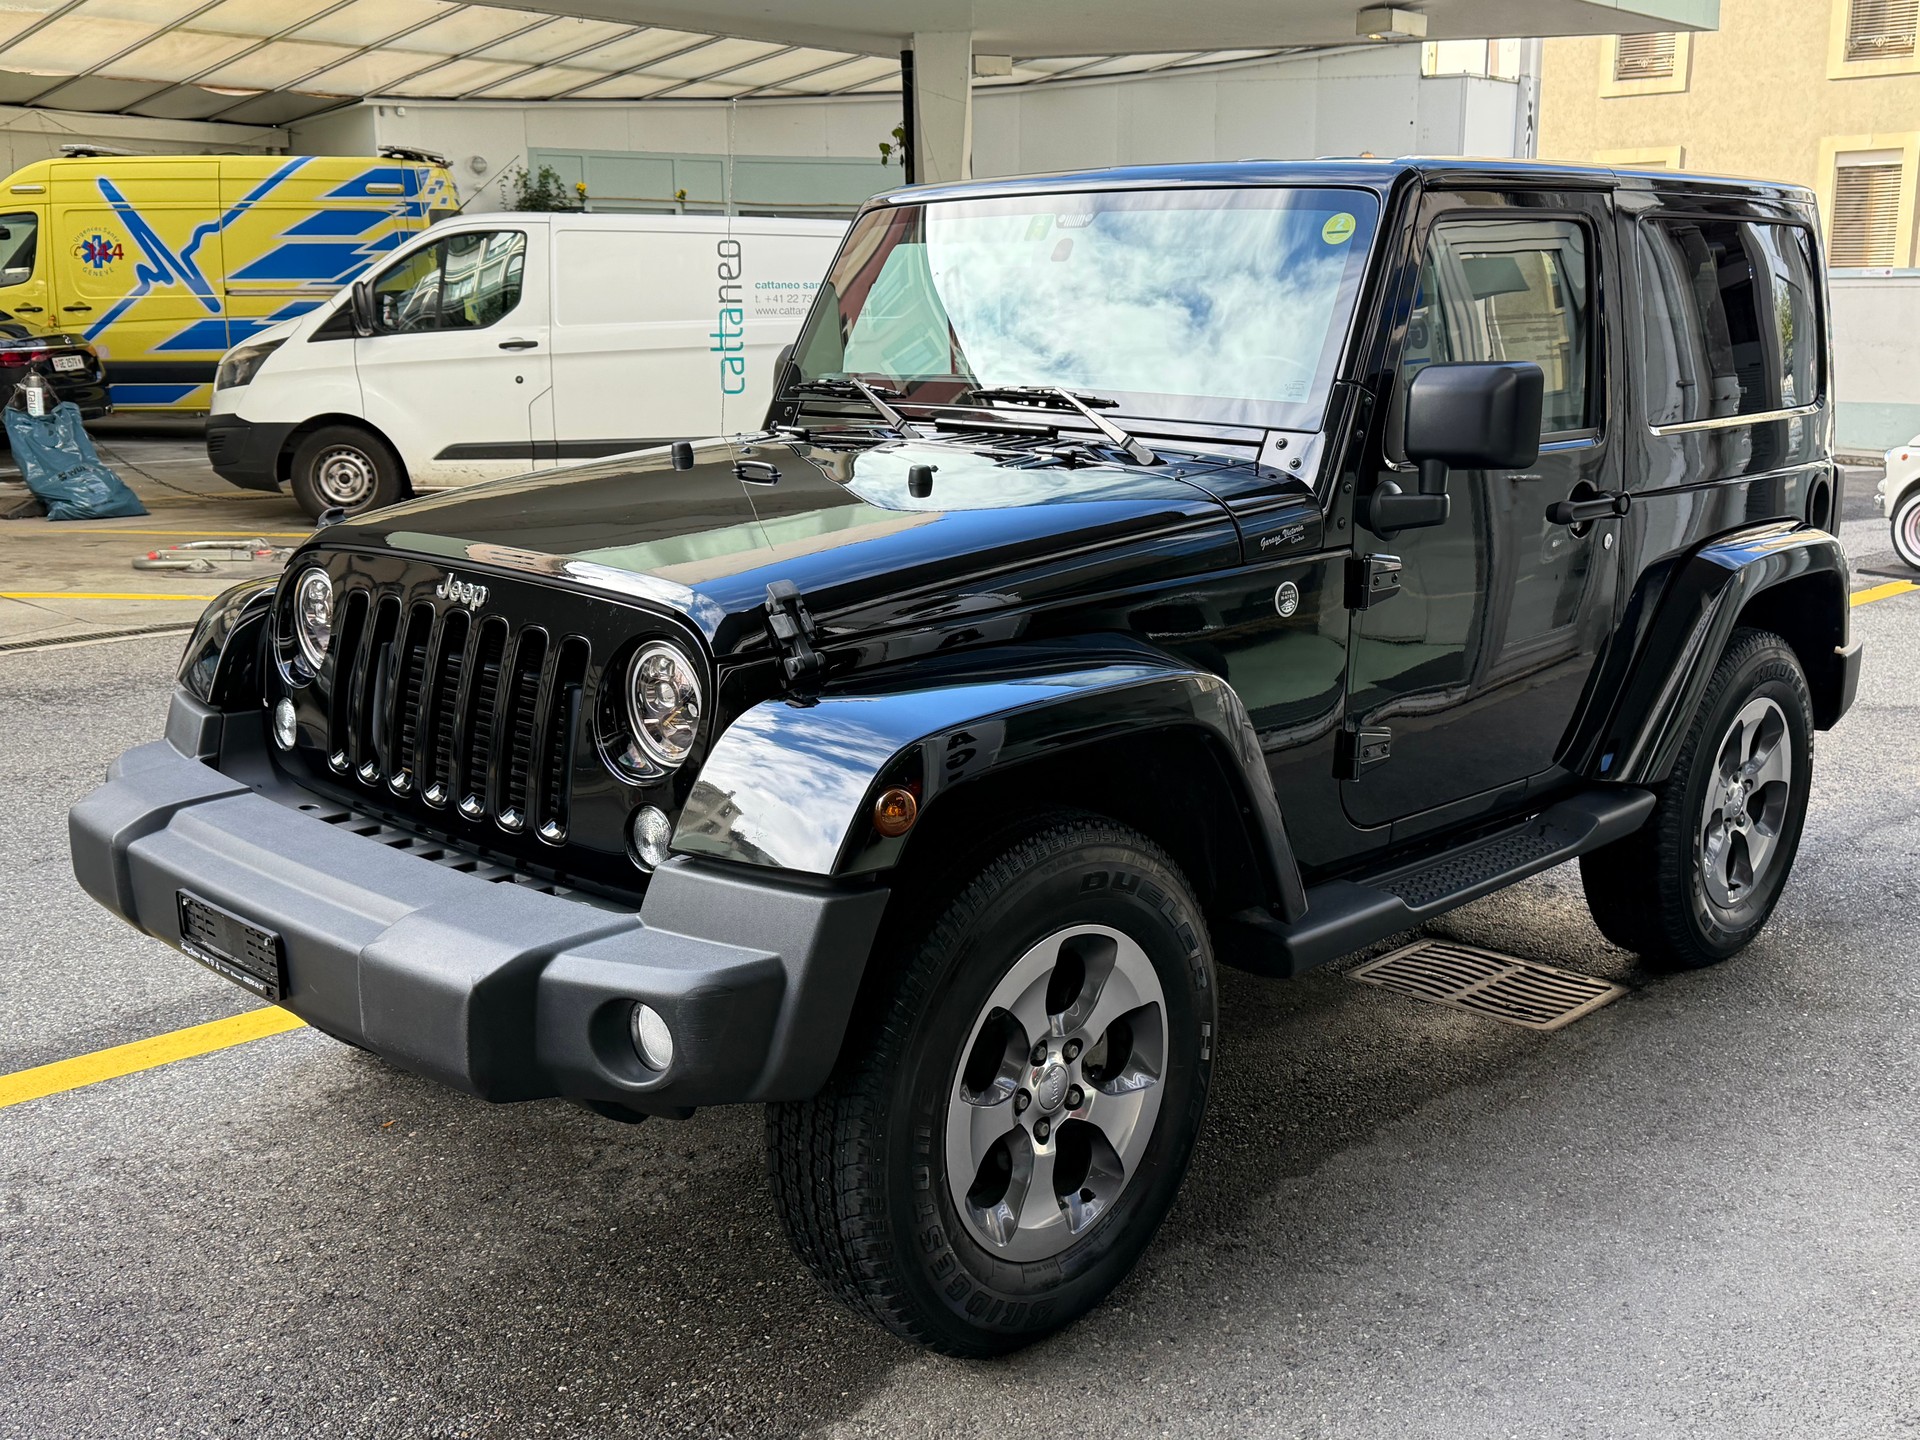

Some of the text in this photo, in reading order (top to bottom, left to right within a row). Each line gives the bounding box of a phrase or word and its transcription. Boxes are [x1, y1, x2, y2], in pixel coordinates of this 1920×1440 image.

[87, 243, 124, 261] 144
[755, 281, 800, 290] cattaneo
[765, 295, 783, 304] +41
[787, 295, 799, 304] 22
[802, 295, 815, 304] 73
[709, 239, 746, 395] cattaneo
[1260, 525, 1304, 551] Garage Victoria
[436, 572, 488, 612] Jeep
[1079, 870, 1208, 991] DUELER
[912, 1090, 1058, 1329] BRIDGESTONE
